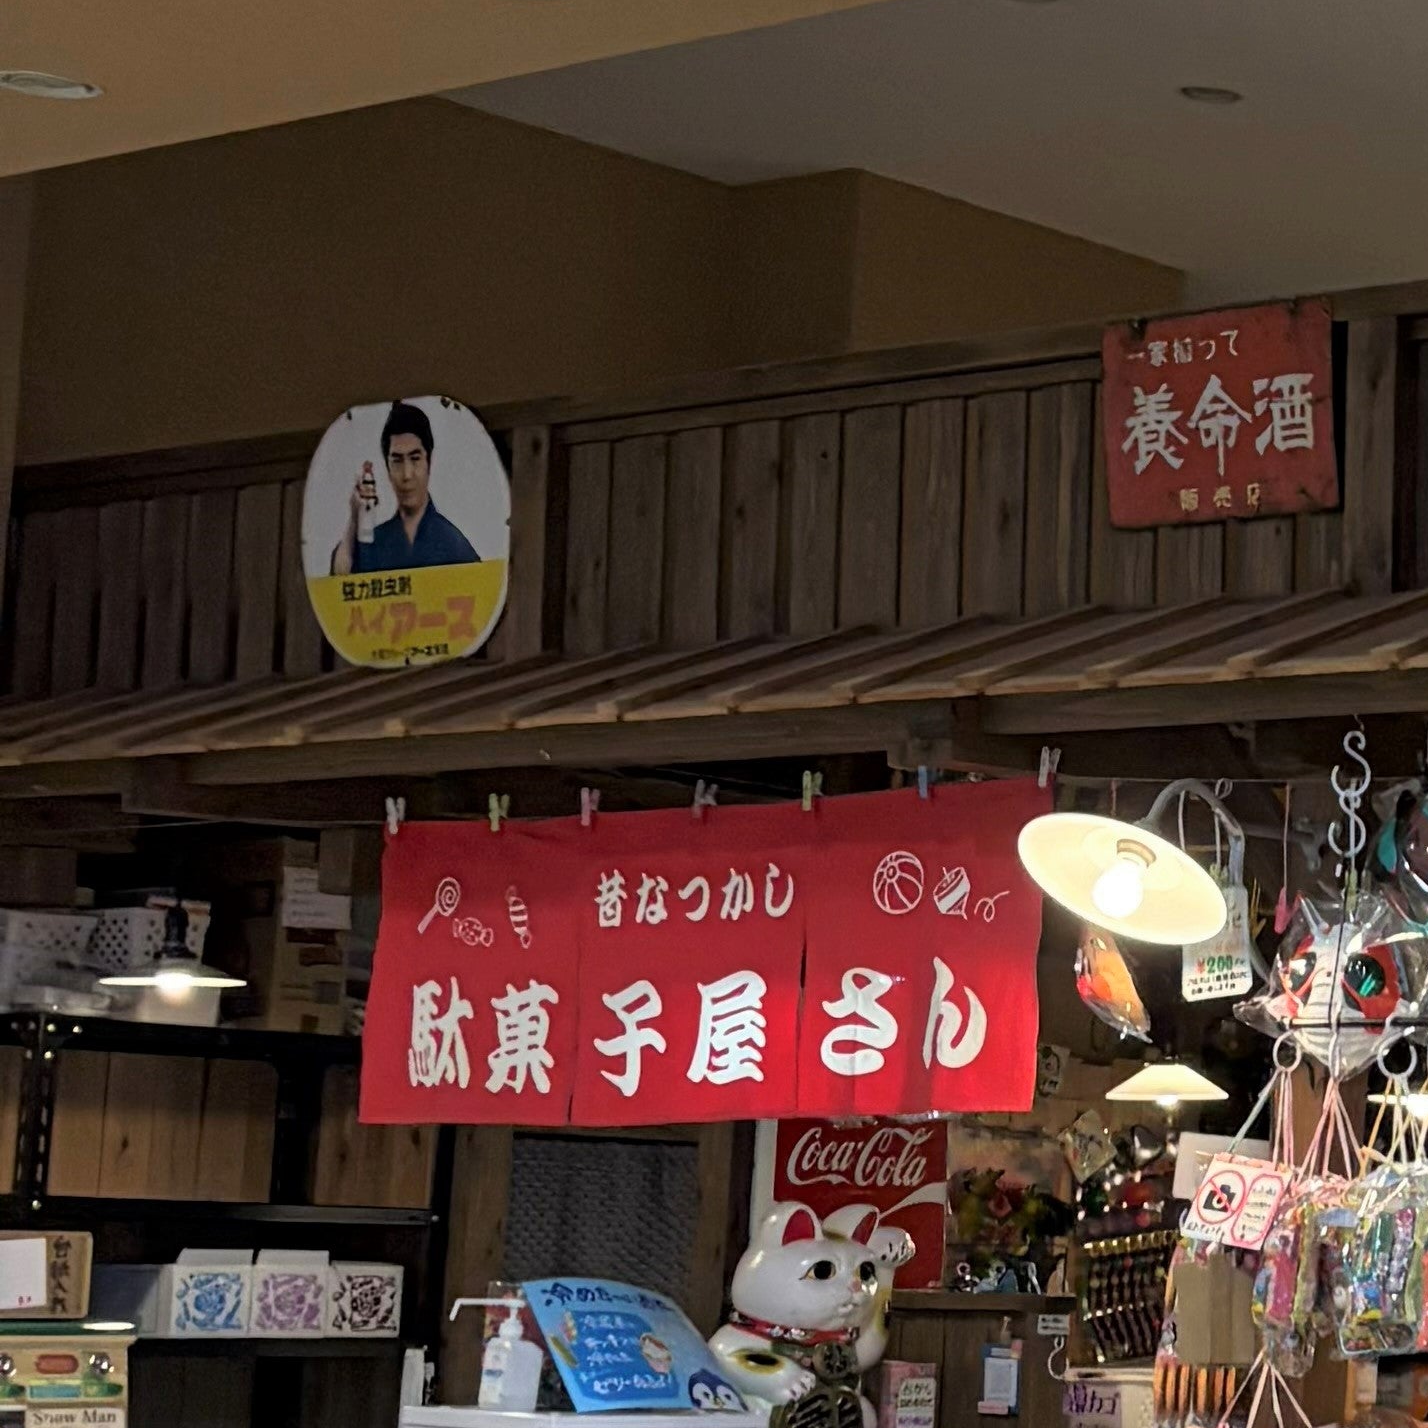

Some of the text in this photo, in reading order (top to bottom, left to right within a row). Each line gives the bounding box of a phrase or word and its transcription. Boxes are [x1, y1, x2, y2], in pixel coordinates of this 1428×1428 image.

[1121, 373, 1315, 477] 養命酒
[347, 595, 477, 644] ハイアース
[594, 862, 795, 928] 昔なつかし
[407, 956, 988, 1098] 駄菓子屋さん
[786, 1124, 927, 1188] Coca-Cola
[33, 1407, 116, 1424] Snow Man
